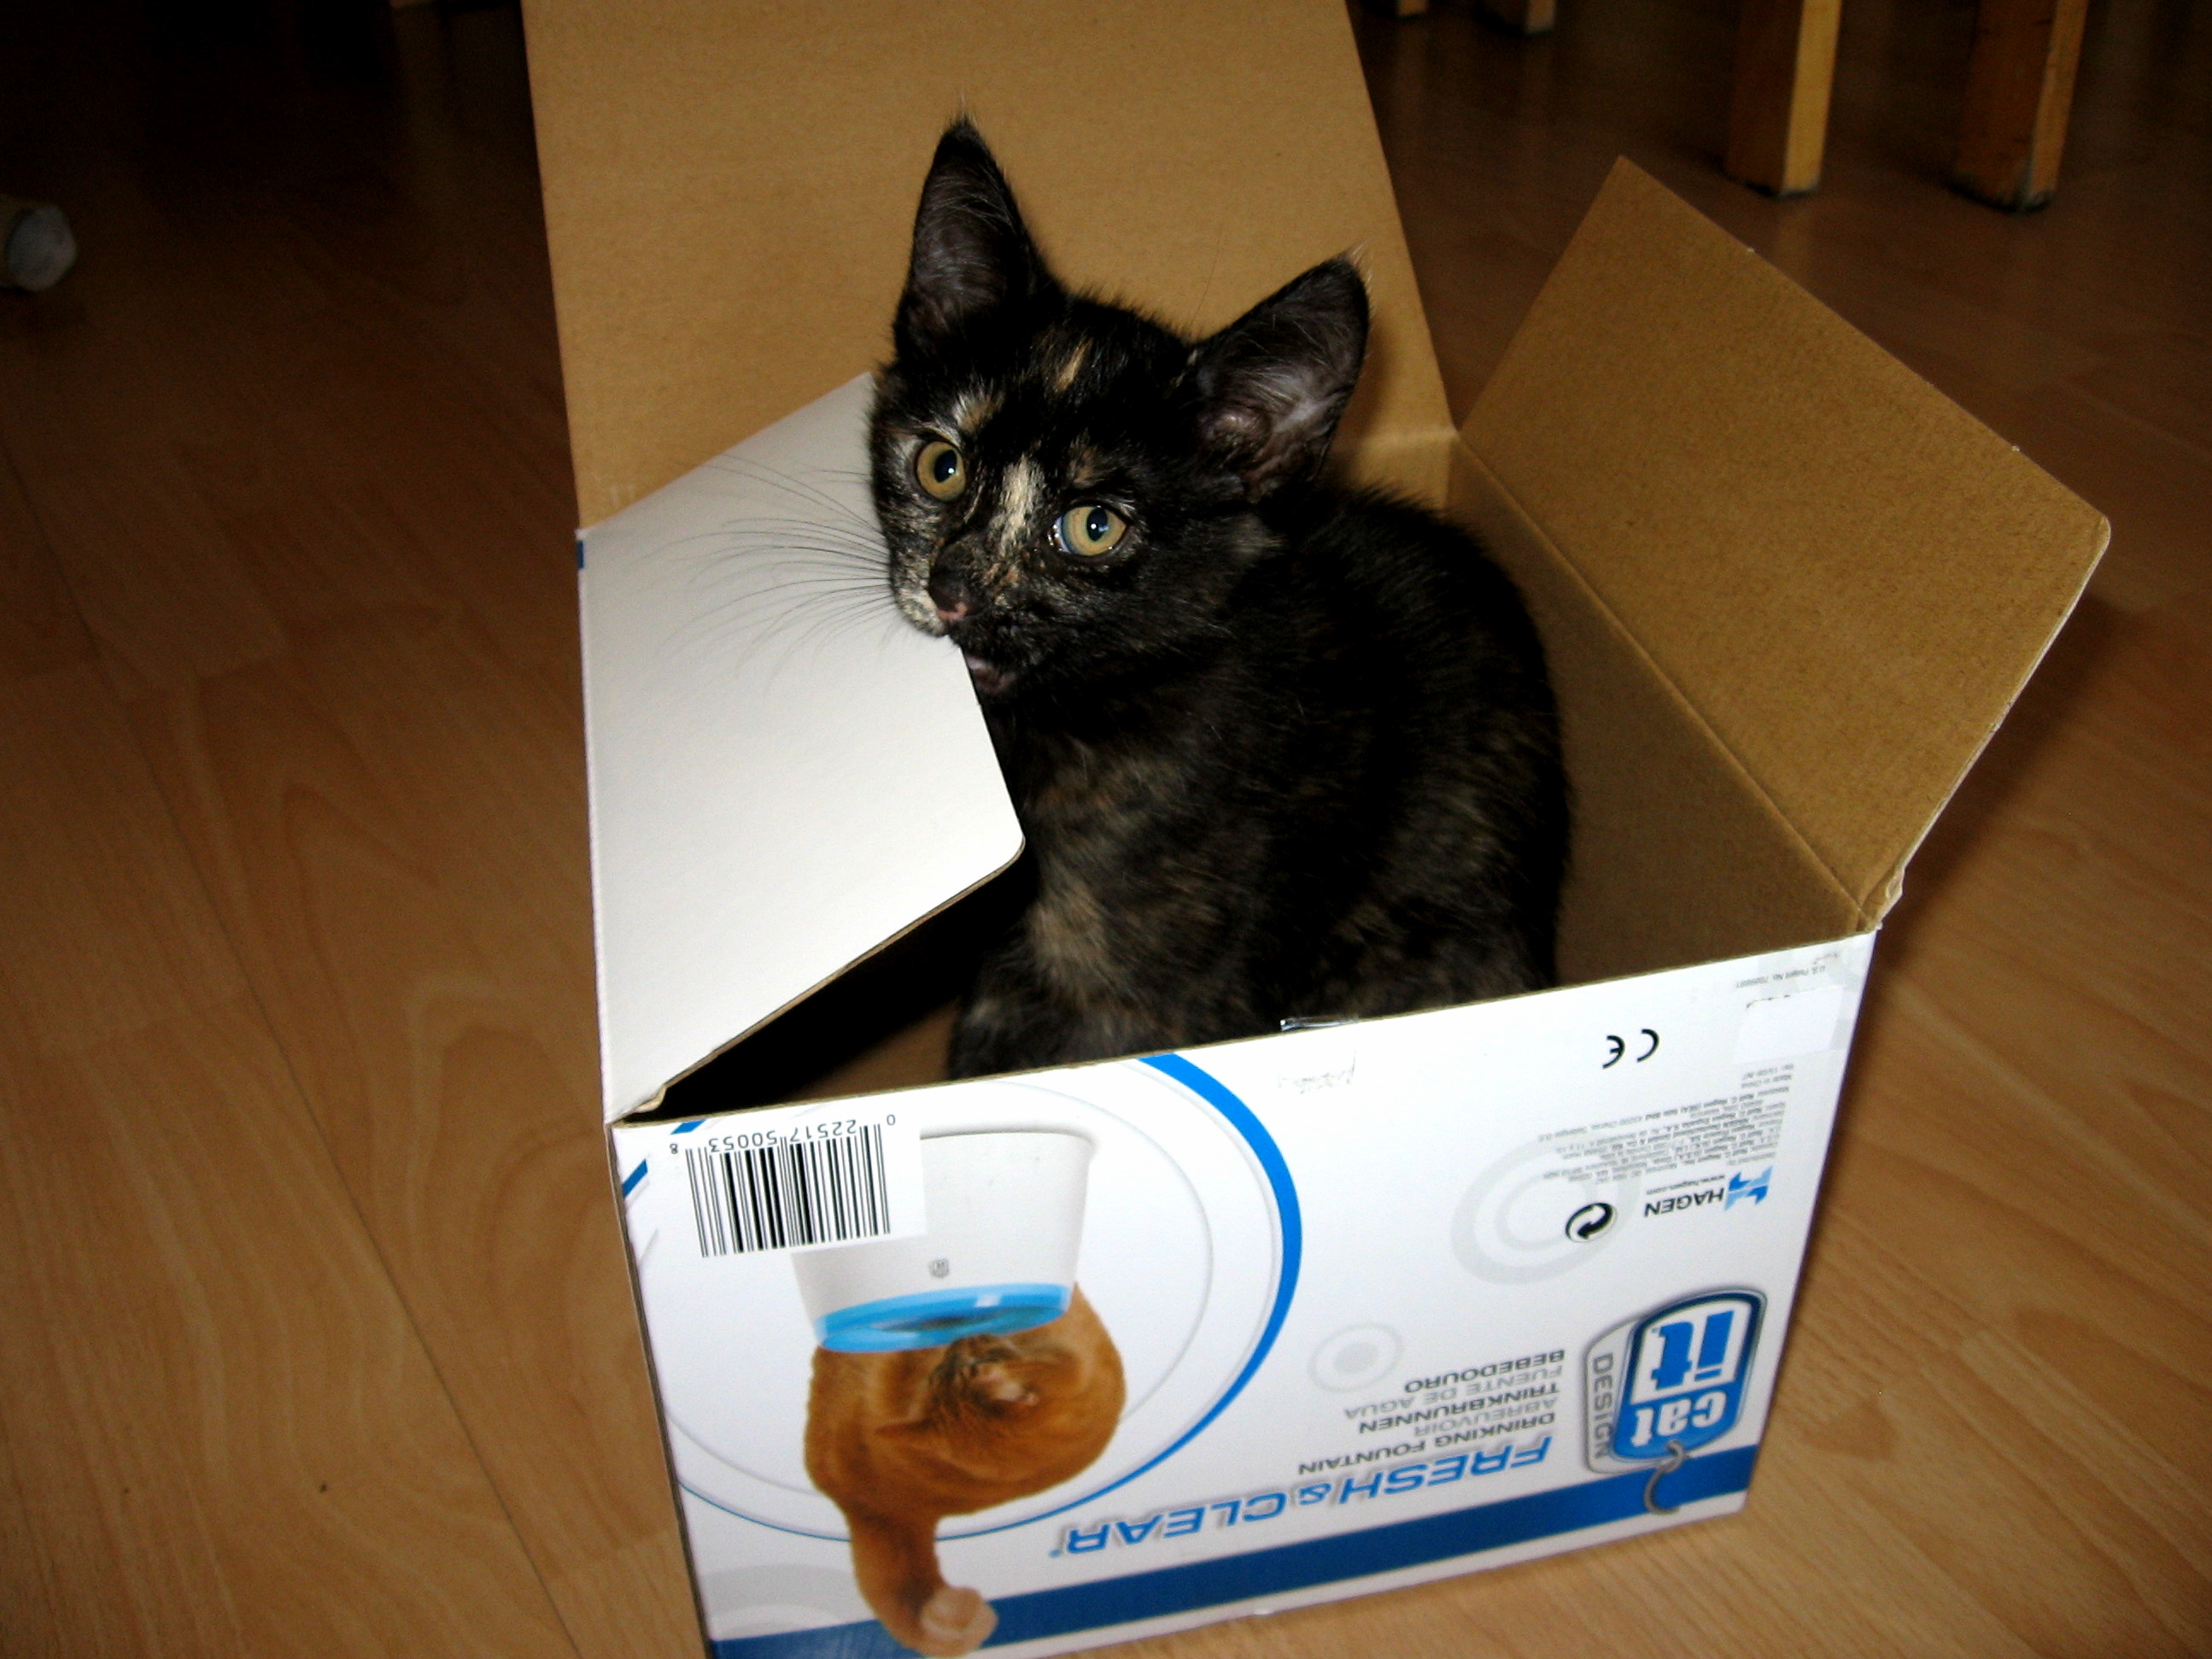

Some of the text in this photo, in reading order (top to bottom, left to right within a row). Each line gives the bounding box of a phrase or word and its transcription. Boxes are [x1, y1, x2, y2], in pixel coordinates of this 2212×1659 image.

[670, 1114, 897, 1154] 0 22517 50053 8
[1644, 1187, 1725, 1217] HAGEN
[1405, 1349, 1565, 1394] BEBEDOURO
[1651, 1310, 1735, 1391] it
[1343, 1365, 1564, 1422] FUENTE DE AGUA
[1359, 1383, 1560, 1434] TRINKBRUNNEN
[1414, 1396, 1558, 1438] ABREUVOIR
[1592, 1352, 1614, 1460] DESIGN
[1630, 1391, 1727, 1447] cat
[1298, 1411, 1556, 1476] DRINKING FOUNTAIN
[1067, 1435, 1554, 1555] FRESH & CLEAR
